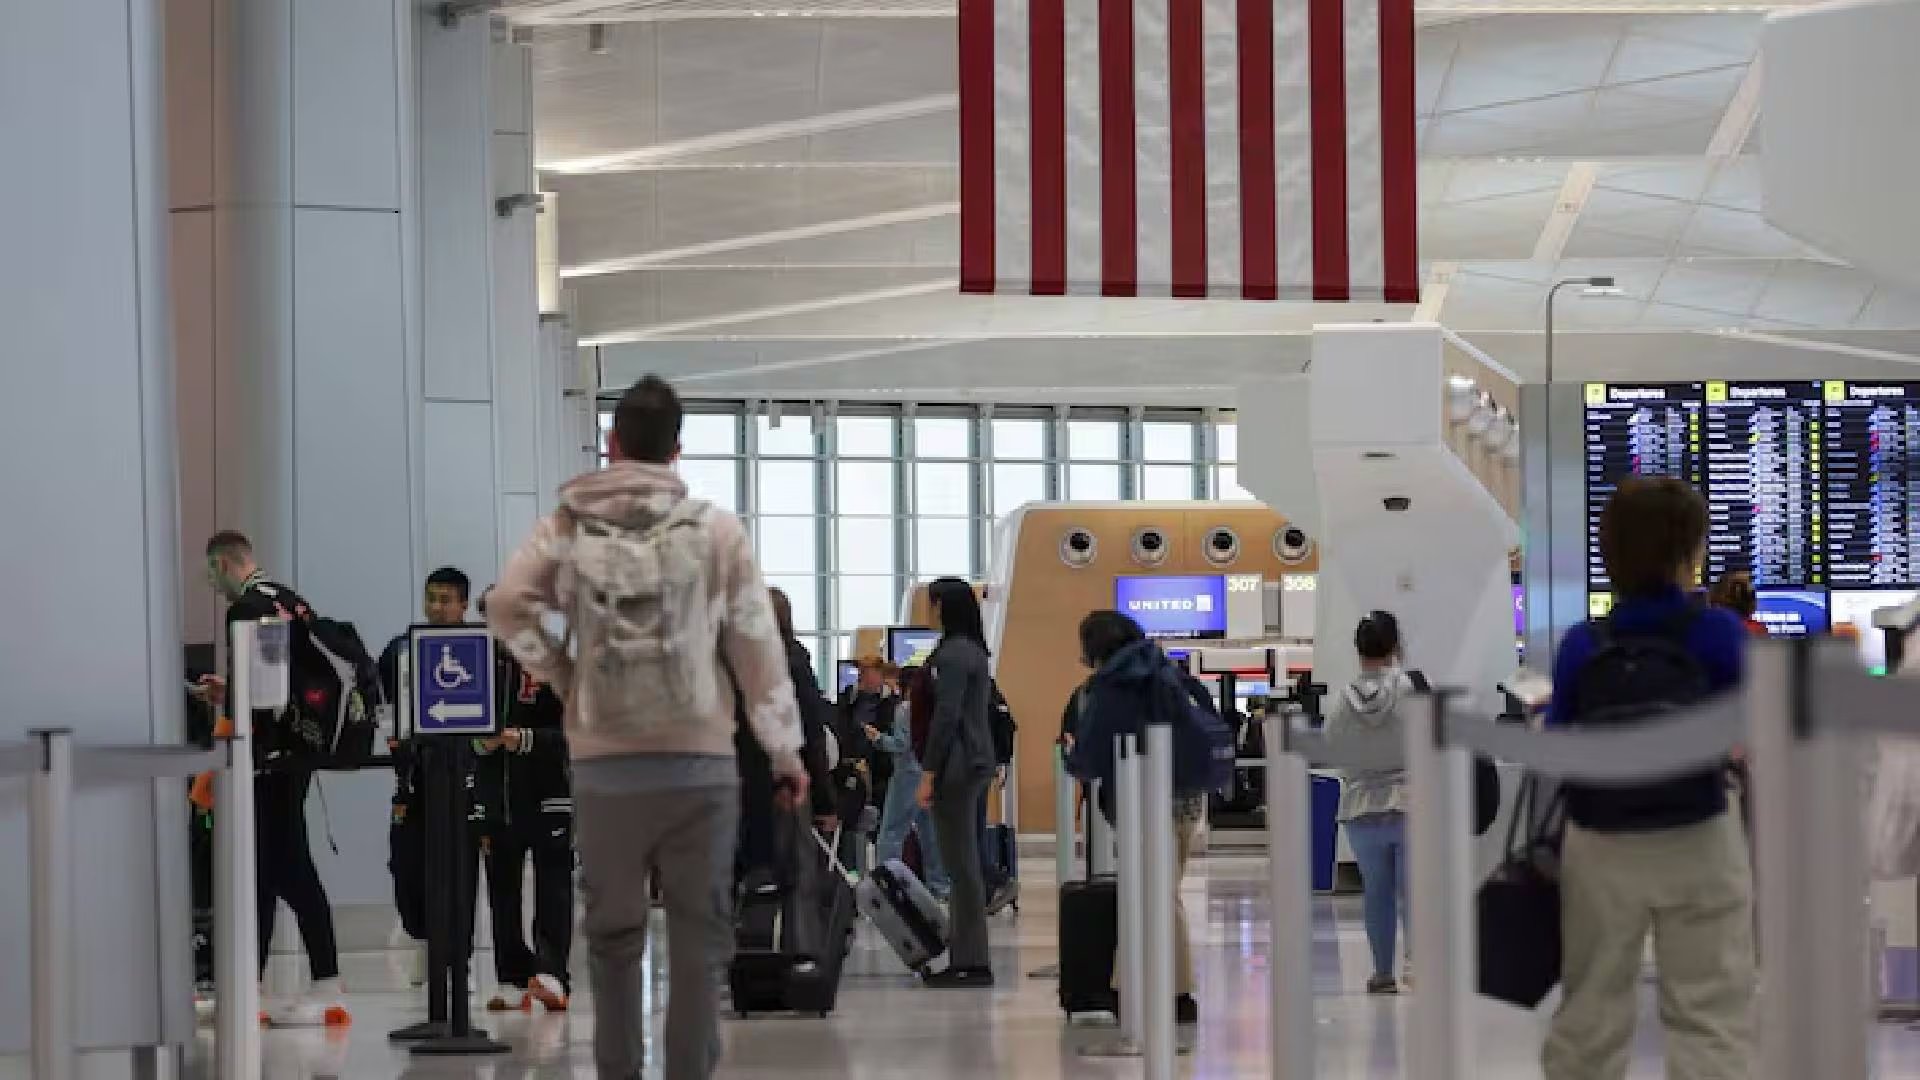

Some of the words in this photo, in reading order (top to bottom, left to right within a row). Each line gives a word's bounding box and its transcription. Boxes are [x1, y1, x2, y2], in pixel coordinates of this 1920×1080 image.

[1610, 387, 1666, 400] Departures
[1730, 386, 1787, 399] Departures
[1850, 385, 1905, 399] Departures
[1228, 575, 1259, 592] 307
[1128, 599, 1193, 611] UNITED
